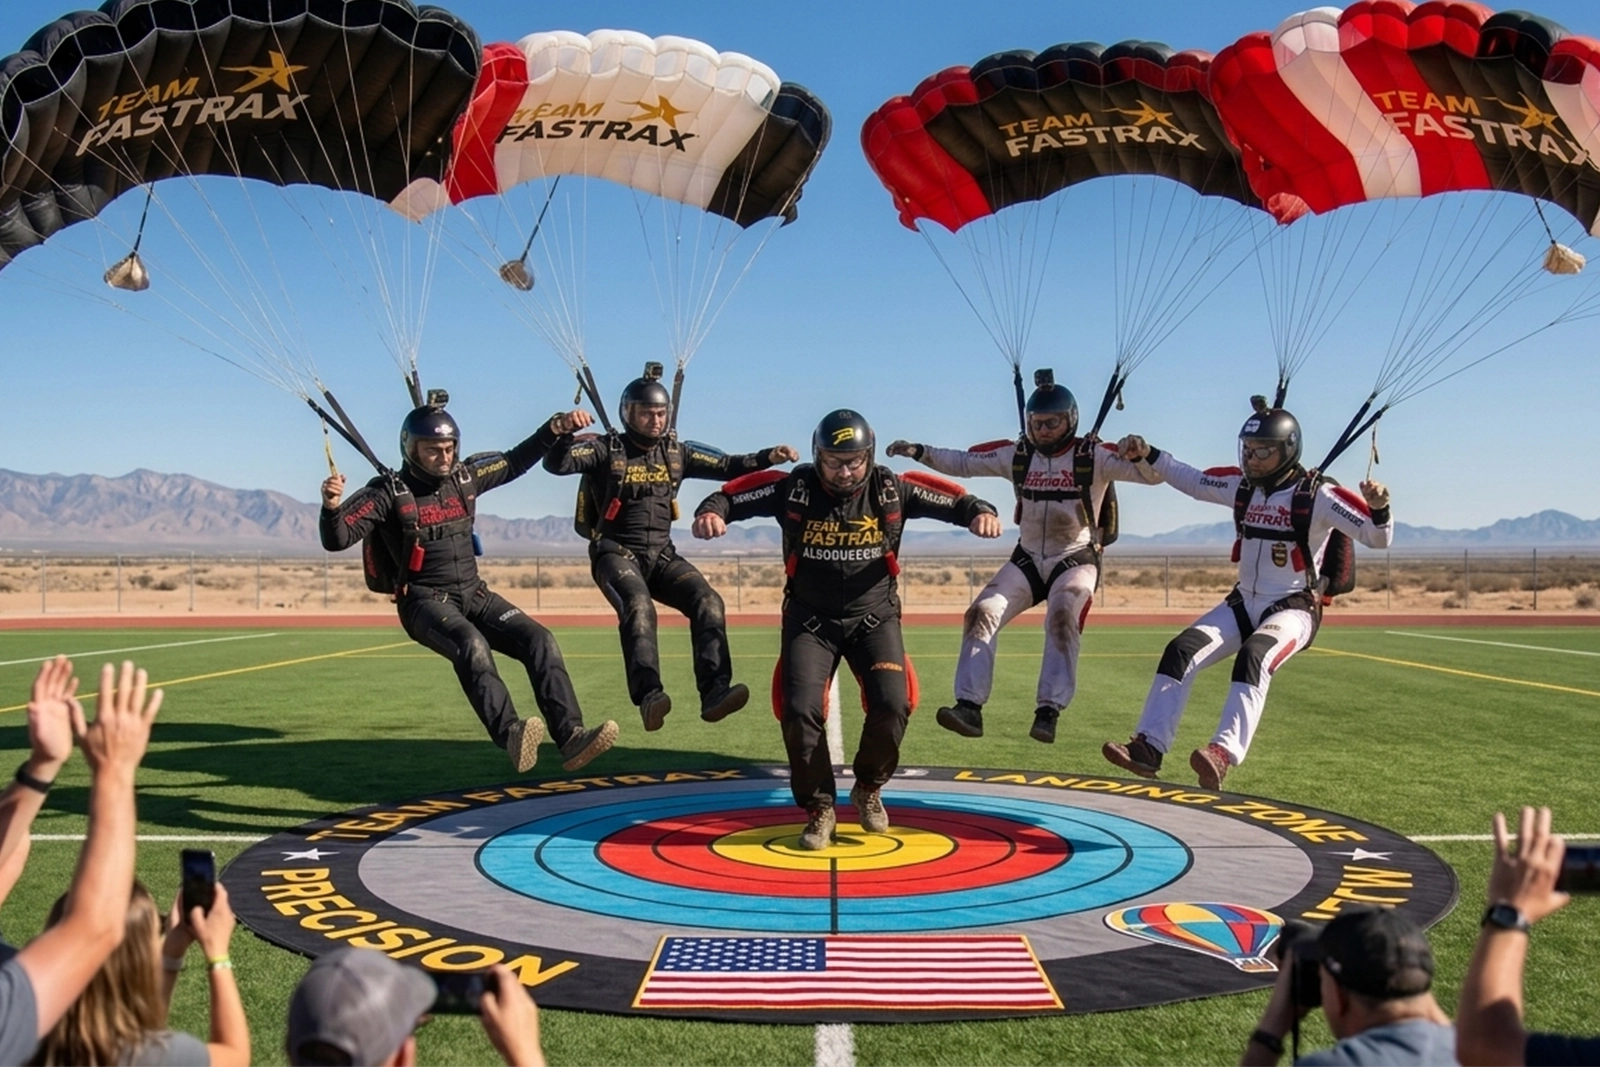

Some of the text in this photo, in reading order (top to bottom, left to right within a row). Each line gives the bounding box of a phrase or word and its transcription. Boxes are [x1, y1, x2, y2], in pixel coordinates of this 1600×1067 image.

[97, 76, 200, 121] TEAM
[514, 102, 605, 124] TEAM
[1373, 90, 1481, 116] TEAM
[75, 92, 311, 157] FASTRAX
[494, 119, 695, 152] FASTRAX
[998, 112, 1094, 137] TEAM
[1005, 124, 1207, 158] FASTRAX
[304, 769, 748, 842] TEAM FASTRAX
[953, 770, 1370, 844] LANDING ZONE
[261, 867, 581, 987] PRECISION
